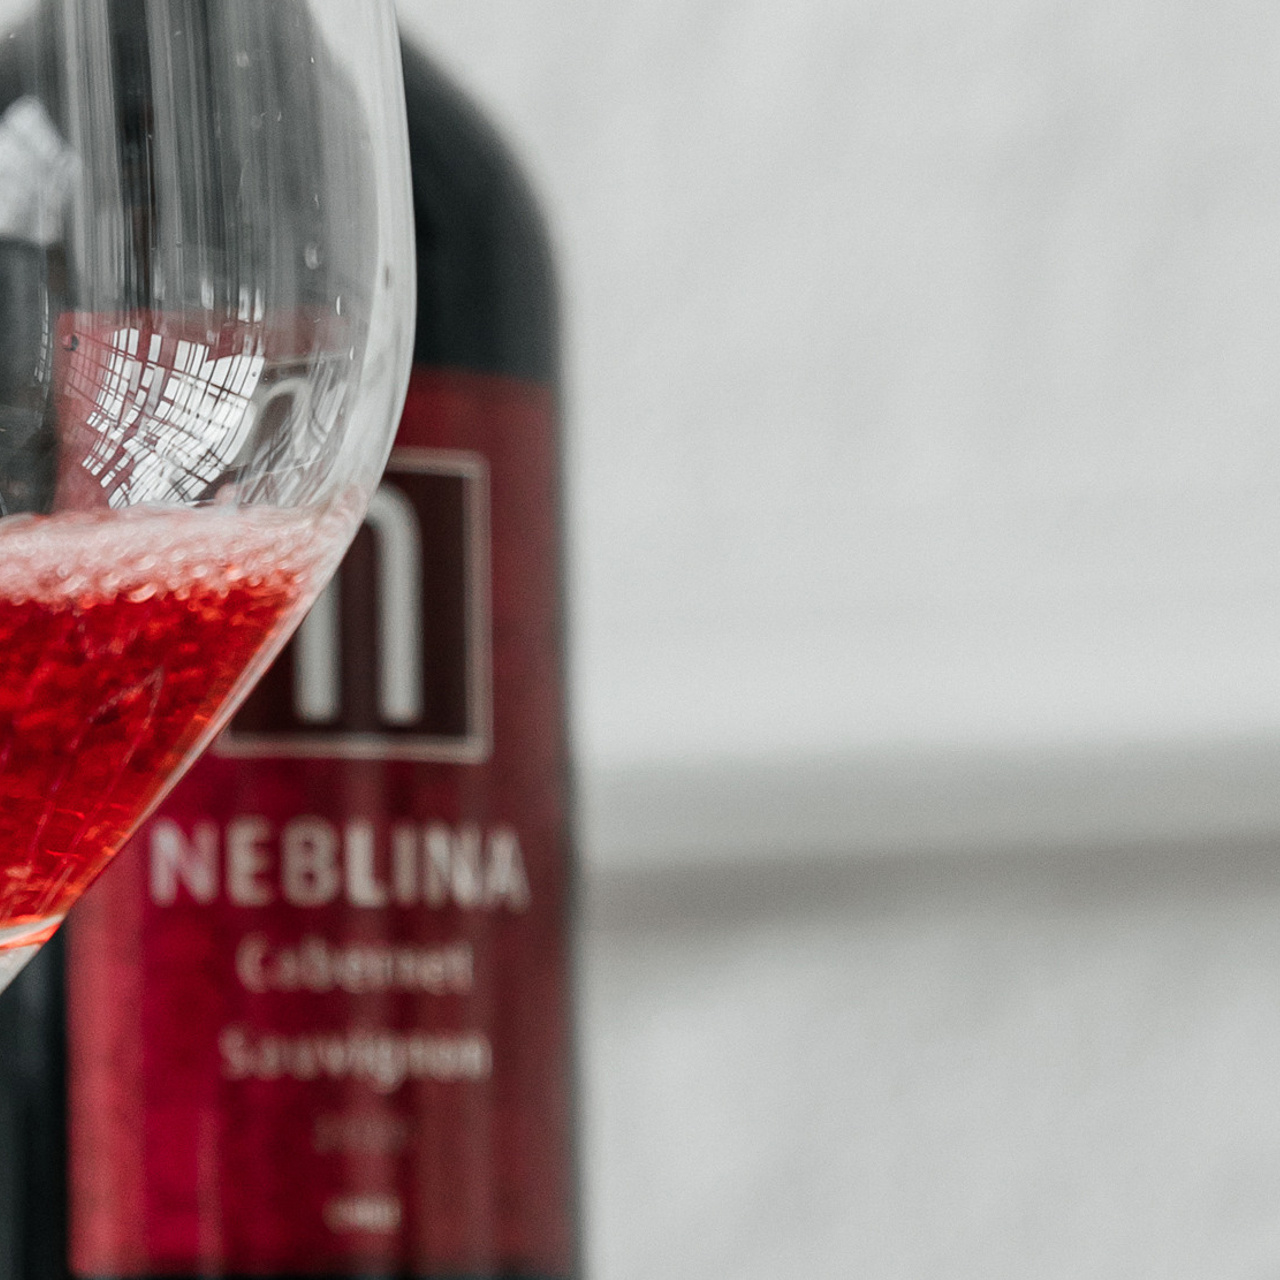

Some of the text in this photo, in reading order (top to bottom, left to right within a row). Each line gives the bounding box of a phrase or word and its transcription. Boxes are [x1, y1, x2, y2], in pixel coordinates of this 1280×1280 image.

[150, 817, 530, 910] NEBLINA
[236, 932, 474, 994] Cabernet
[220, 1025, 493, 1093] Sauvignon
